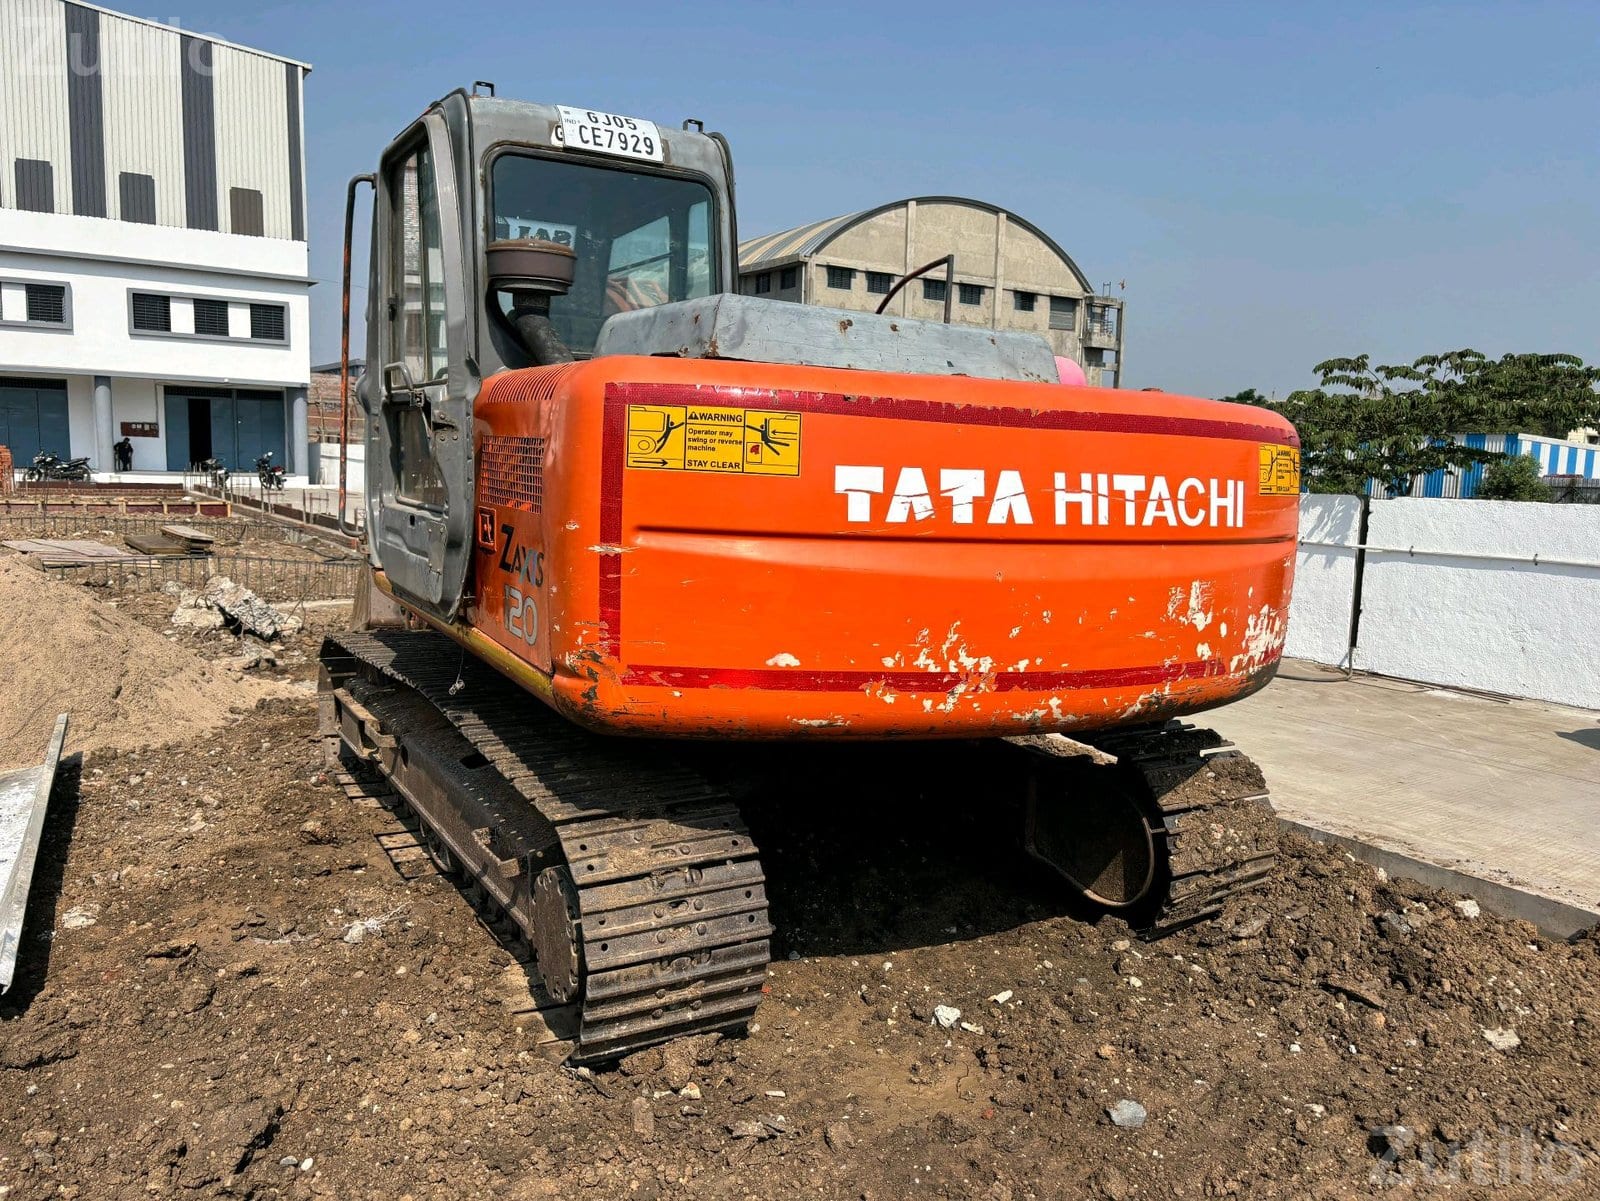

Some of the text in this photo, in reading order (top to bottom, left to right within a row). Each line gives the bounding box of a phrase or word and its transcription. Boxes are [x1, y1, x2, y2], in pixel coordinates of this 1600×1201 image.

[587, 111, 637, 131] GJ05
[579, 125, 654, 156] CE7929
[699, 412, 742, 422] WARNING
[687, 459, 740, 469] STAY CLEAR
[834, 464, 1244, 528] TATA HITACHI
[499, 523, 545, 588] ZAXIS
[504, 583, 538, 646] 120
